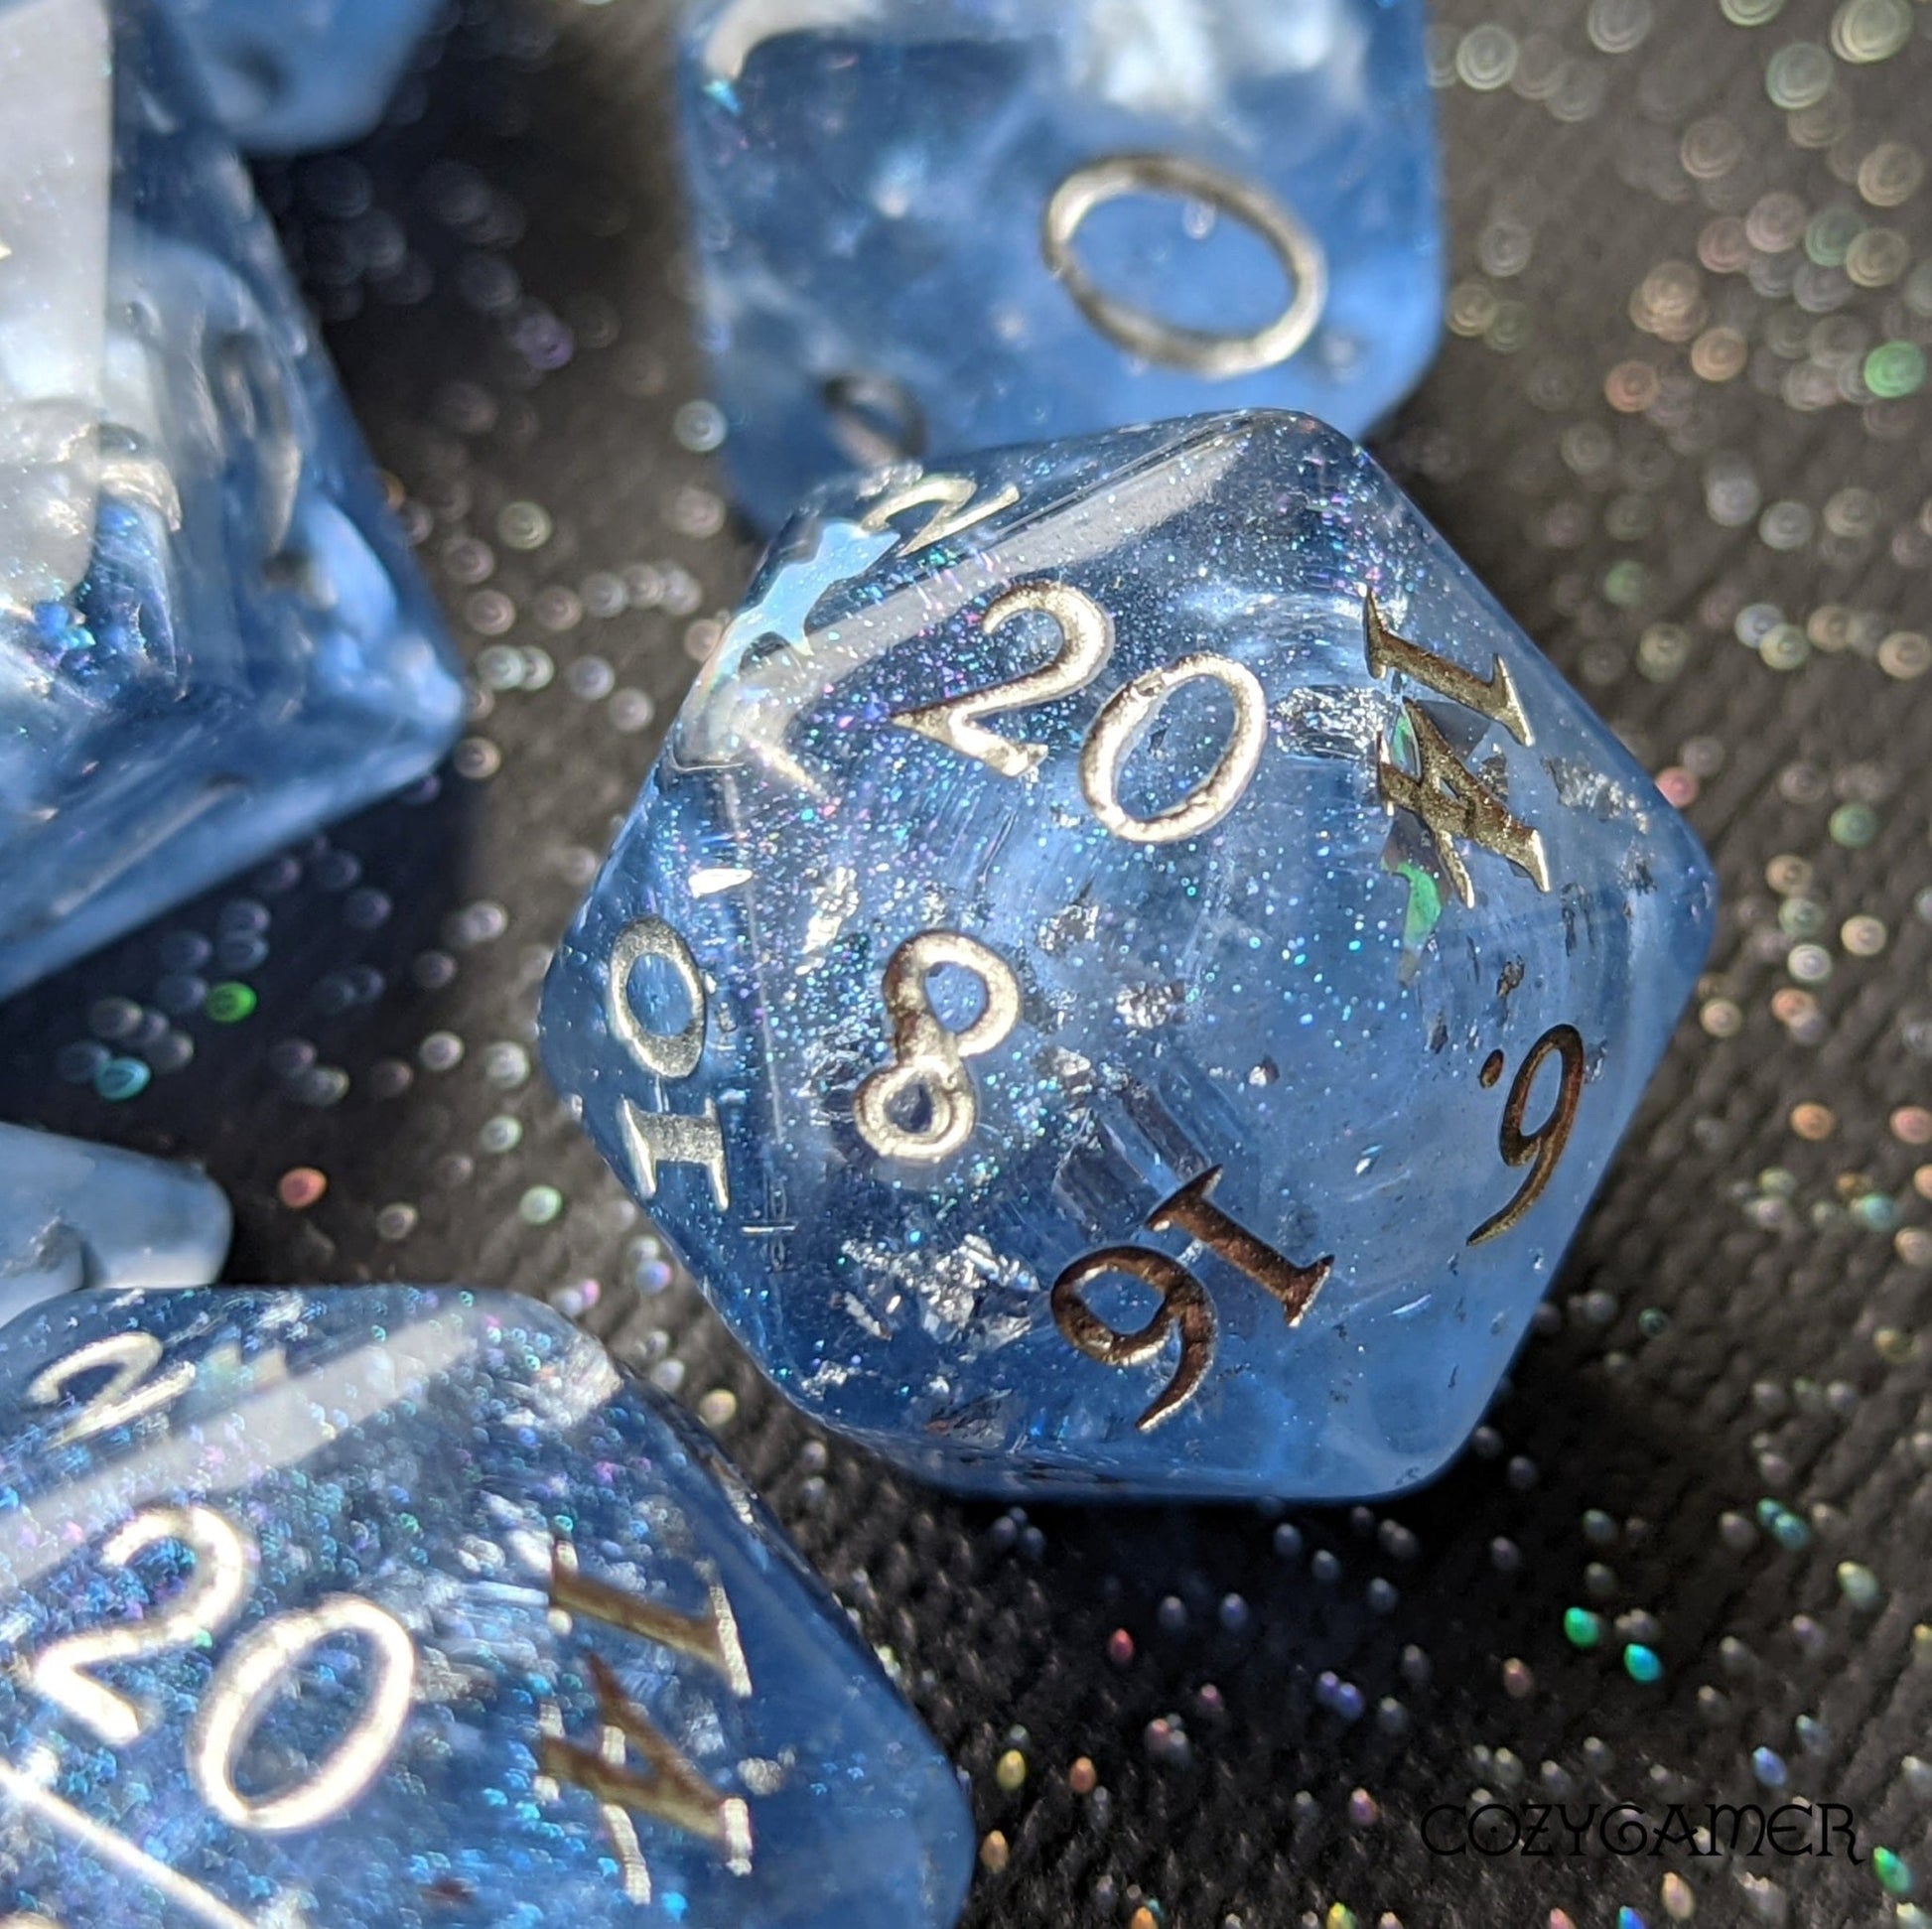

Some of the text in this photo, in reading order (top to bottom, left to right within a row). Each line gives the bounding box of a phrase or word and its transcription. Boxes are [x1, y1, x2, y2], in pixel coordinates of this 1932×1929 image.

[892, 579, 1270, 845] 20
[1362, 588, 1552, 909] 14
[853, 929, 1021, 1162] 8
[32, 1503, 415, 1833] 20
